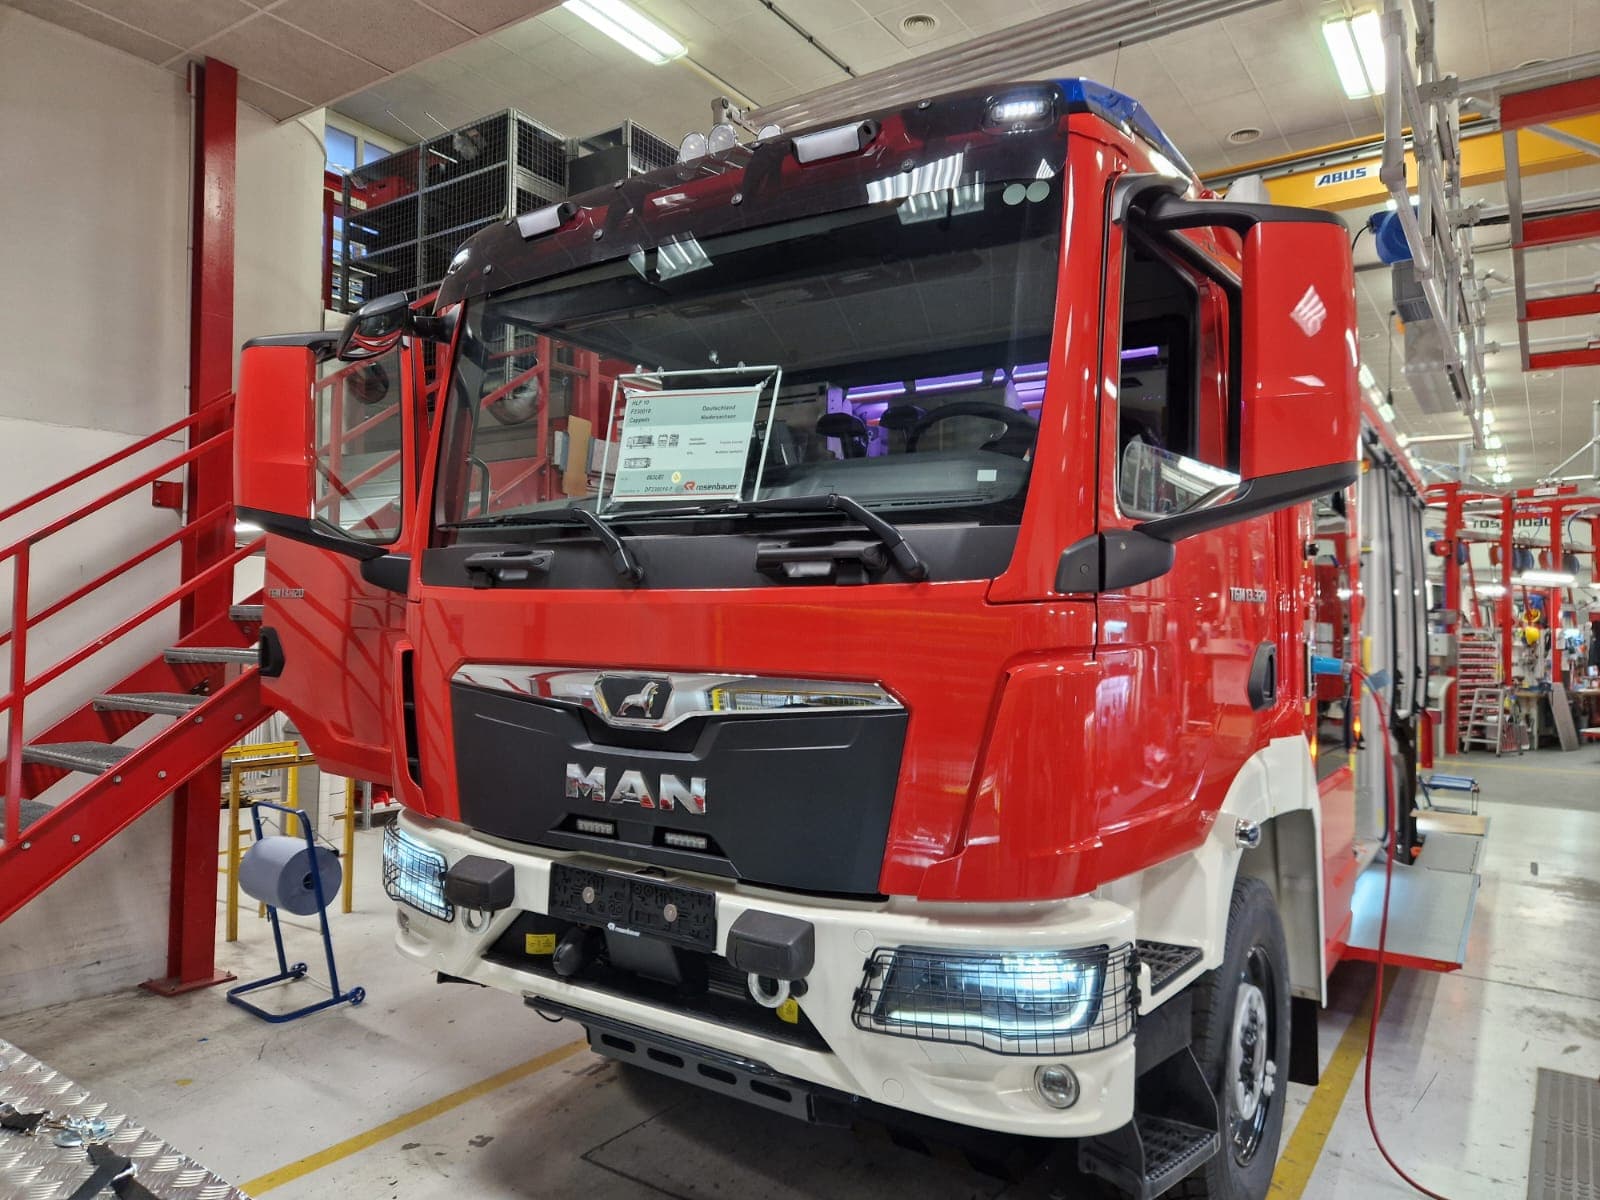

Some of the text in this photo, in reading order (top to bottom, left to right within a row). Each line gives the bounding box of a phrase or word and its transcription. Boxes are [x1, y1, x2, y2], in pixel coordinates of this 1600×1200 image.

[1318, 167, 1367, 186] ABUS
[696, 482, 738, 492] rosenbauer
[566, 763, 706, 815] MAN
